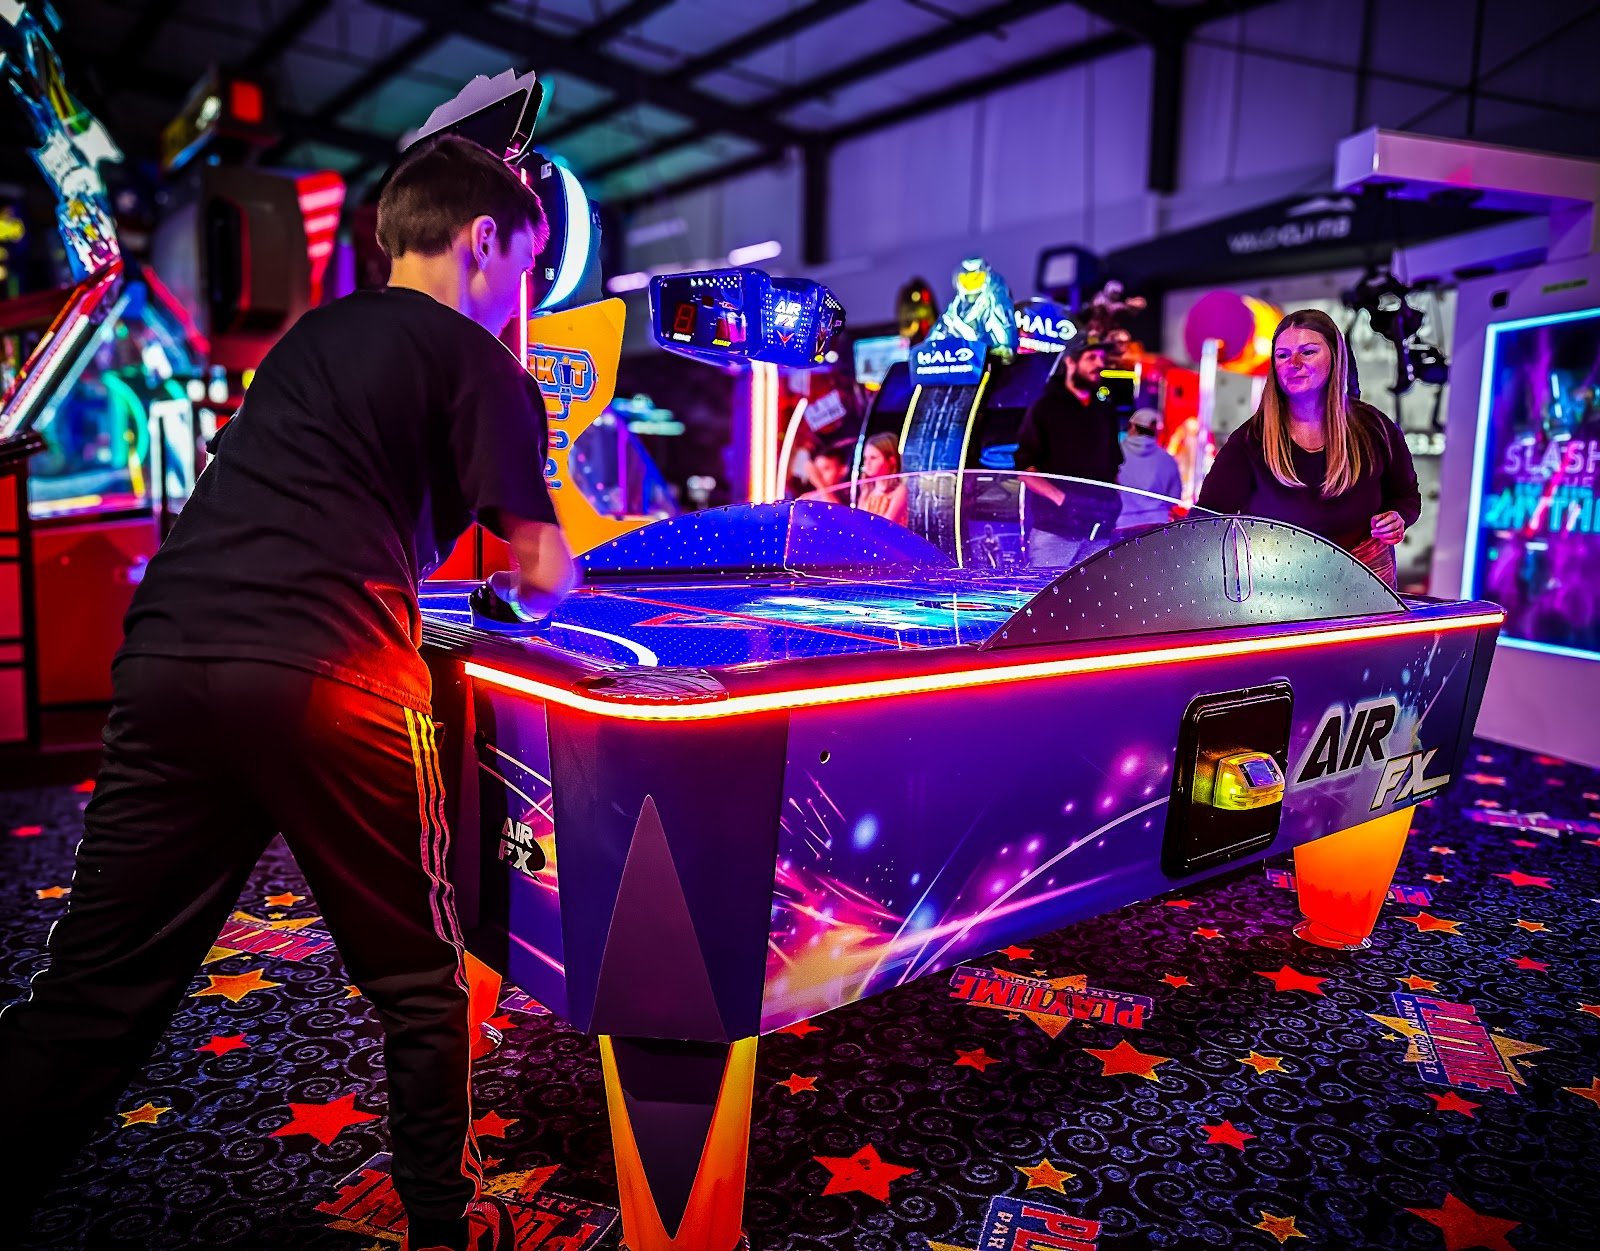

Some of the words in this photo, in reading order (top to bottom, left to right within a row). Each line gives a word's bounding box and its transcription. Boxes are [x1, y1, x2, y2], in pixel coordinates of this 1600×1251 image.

[773, 314, 799, 329] FX
[774, 300, 802, 316] AIR
[1014, 310, 1078, 341] HALO
[917, 347, 975, 366] HALO
[1503, 440, 1600, 474] SLASH
[1294, 701, 1397, 785] AIR
[1369, 748, 1450, 812] FX
[501, 817, 533, 848] AIR
[498, 839, 537, 879] FX
[950, 975, 1147, 1030] PLAYTIME
[1415, 996, 1518, 1095] PLAYTIME
[986, 1211, 1014, 1249] PAR
